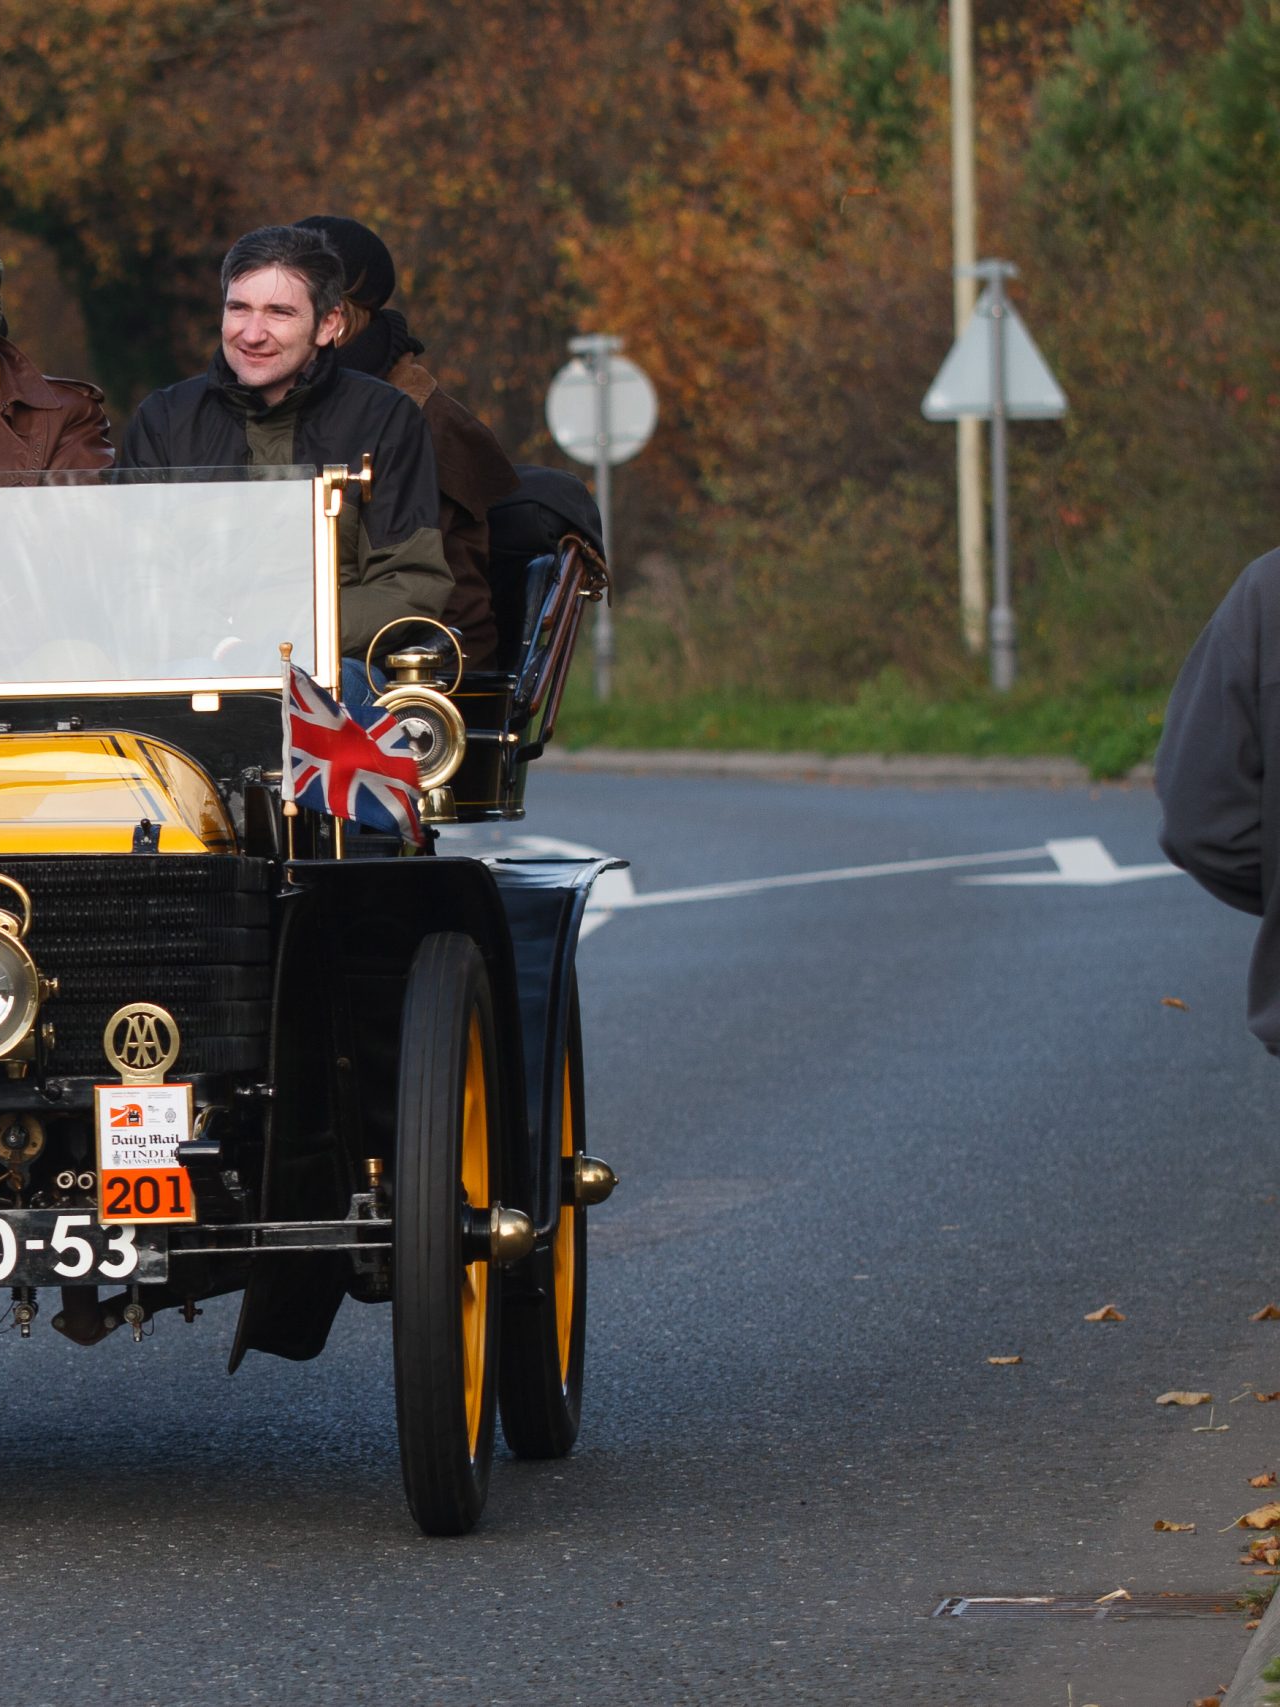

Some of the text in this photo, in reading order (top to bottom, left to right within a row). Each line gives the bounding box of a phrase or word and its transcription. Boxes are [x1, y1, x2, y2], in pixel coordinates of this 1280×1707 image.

[111, 1133, 180, 1148] Daily Mail
[106, 1175, 186, 1215] 201
